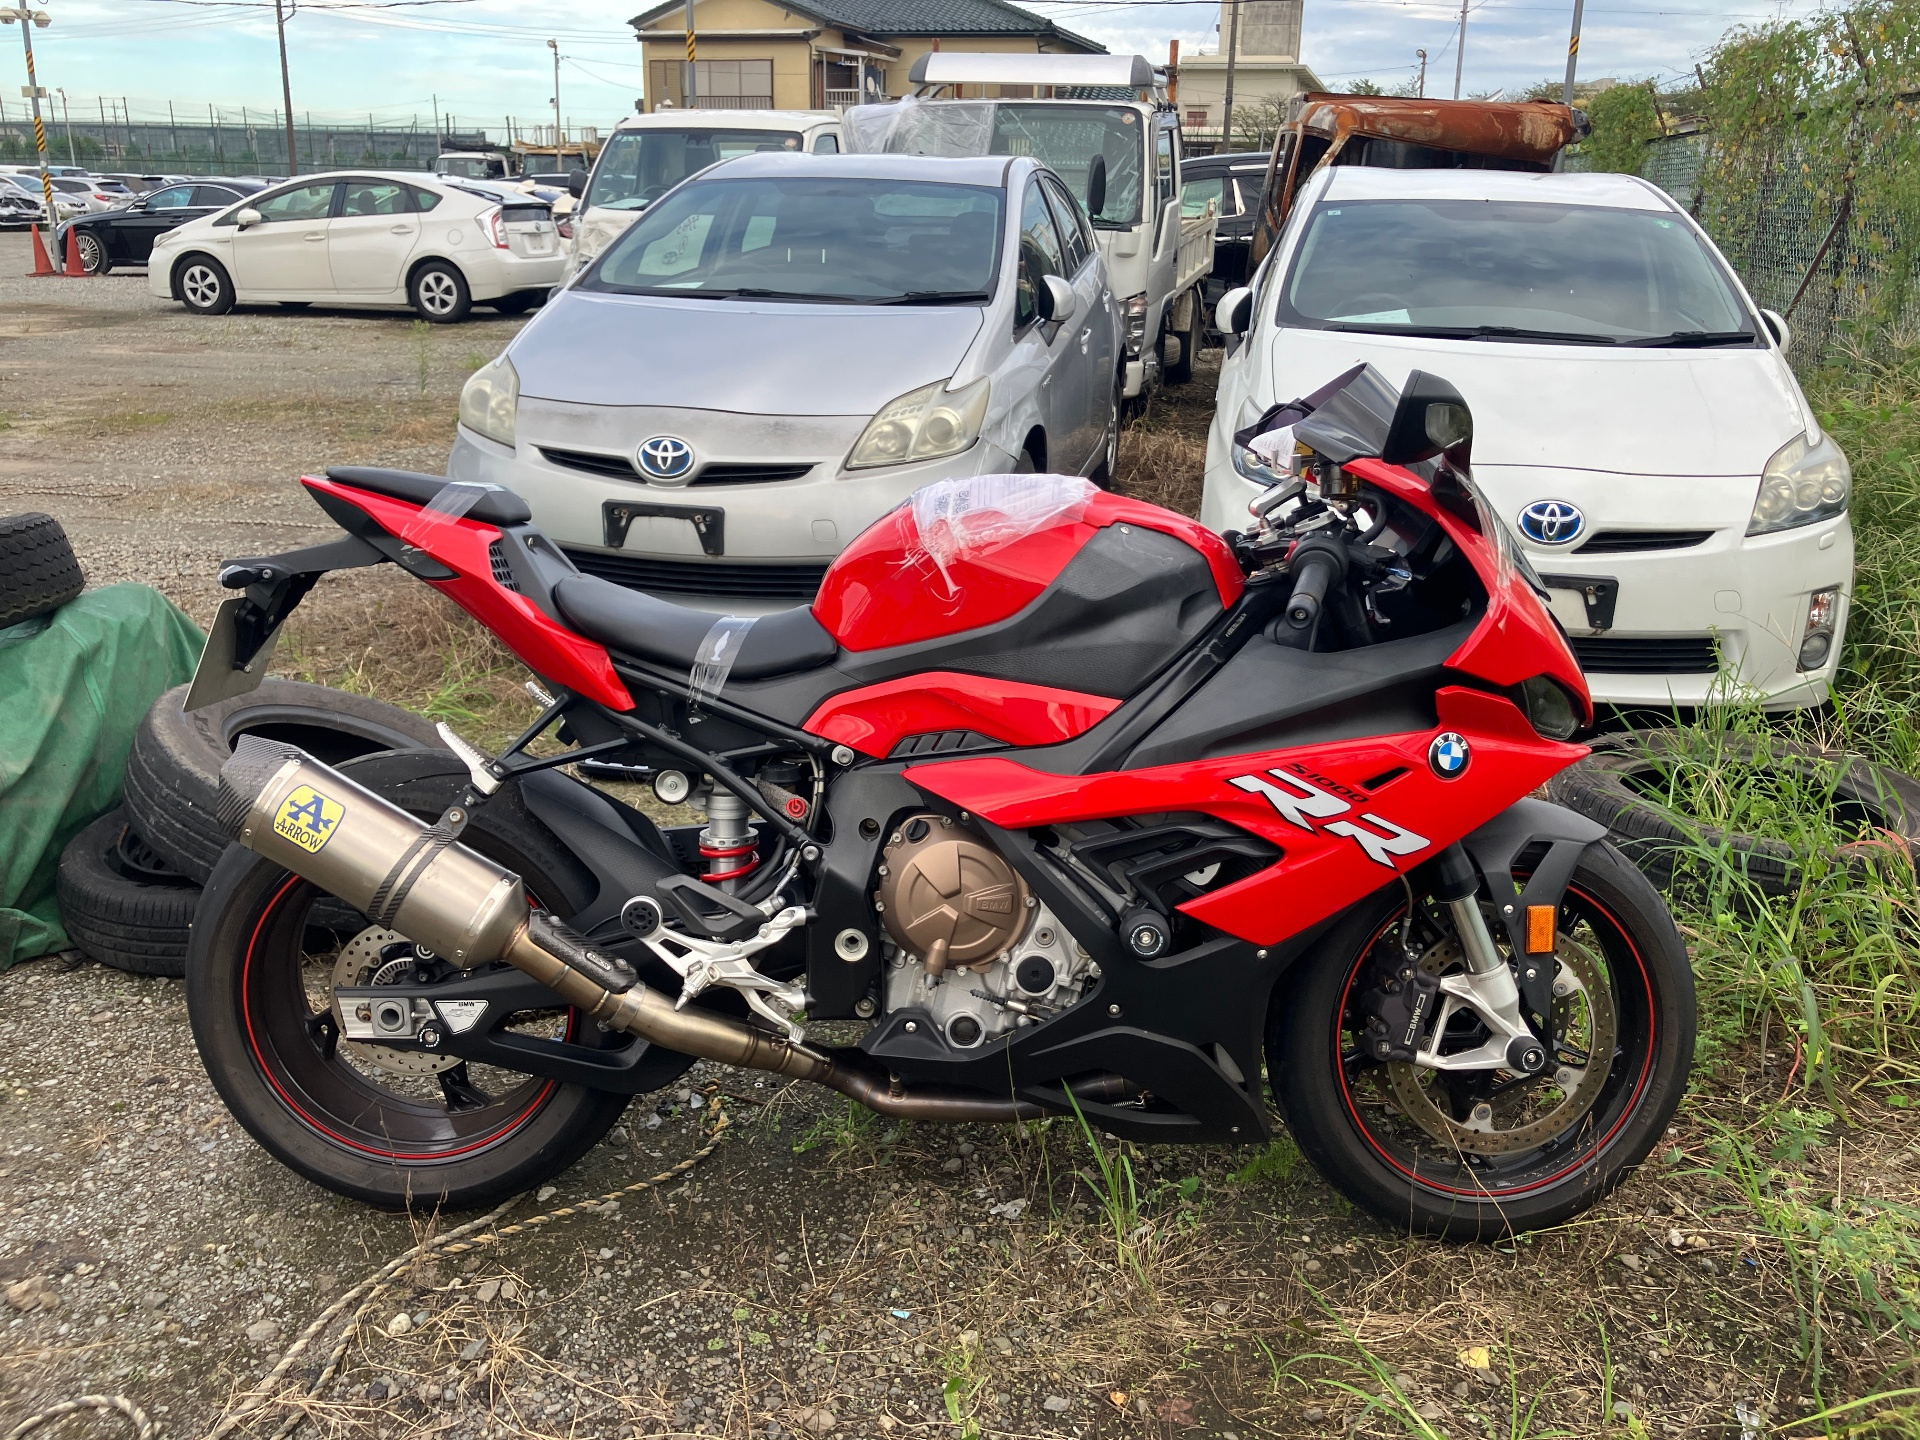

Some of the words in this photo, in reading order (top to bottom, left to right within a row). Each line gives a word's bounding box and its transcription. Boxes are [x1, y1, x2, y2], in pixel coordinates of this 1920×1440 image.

[1435, 733, 1468, 750] BMW
[1223, 768, 1431, 871] RR
[275, 818, 323, 850] ARROW
[981, 900, 1009, 910] BMW
[1410, 1006, 1422, 1030] BMW
